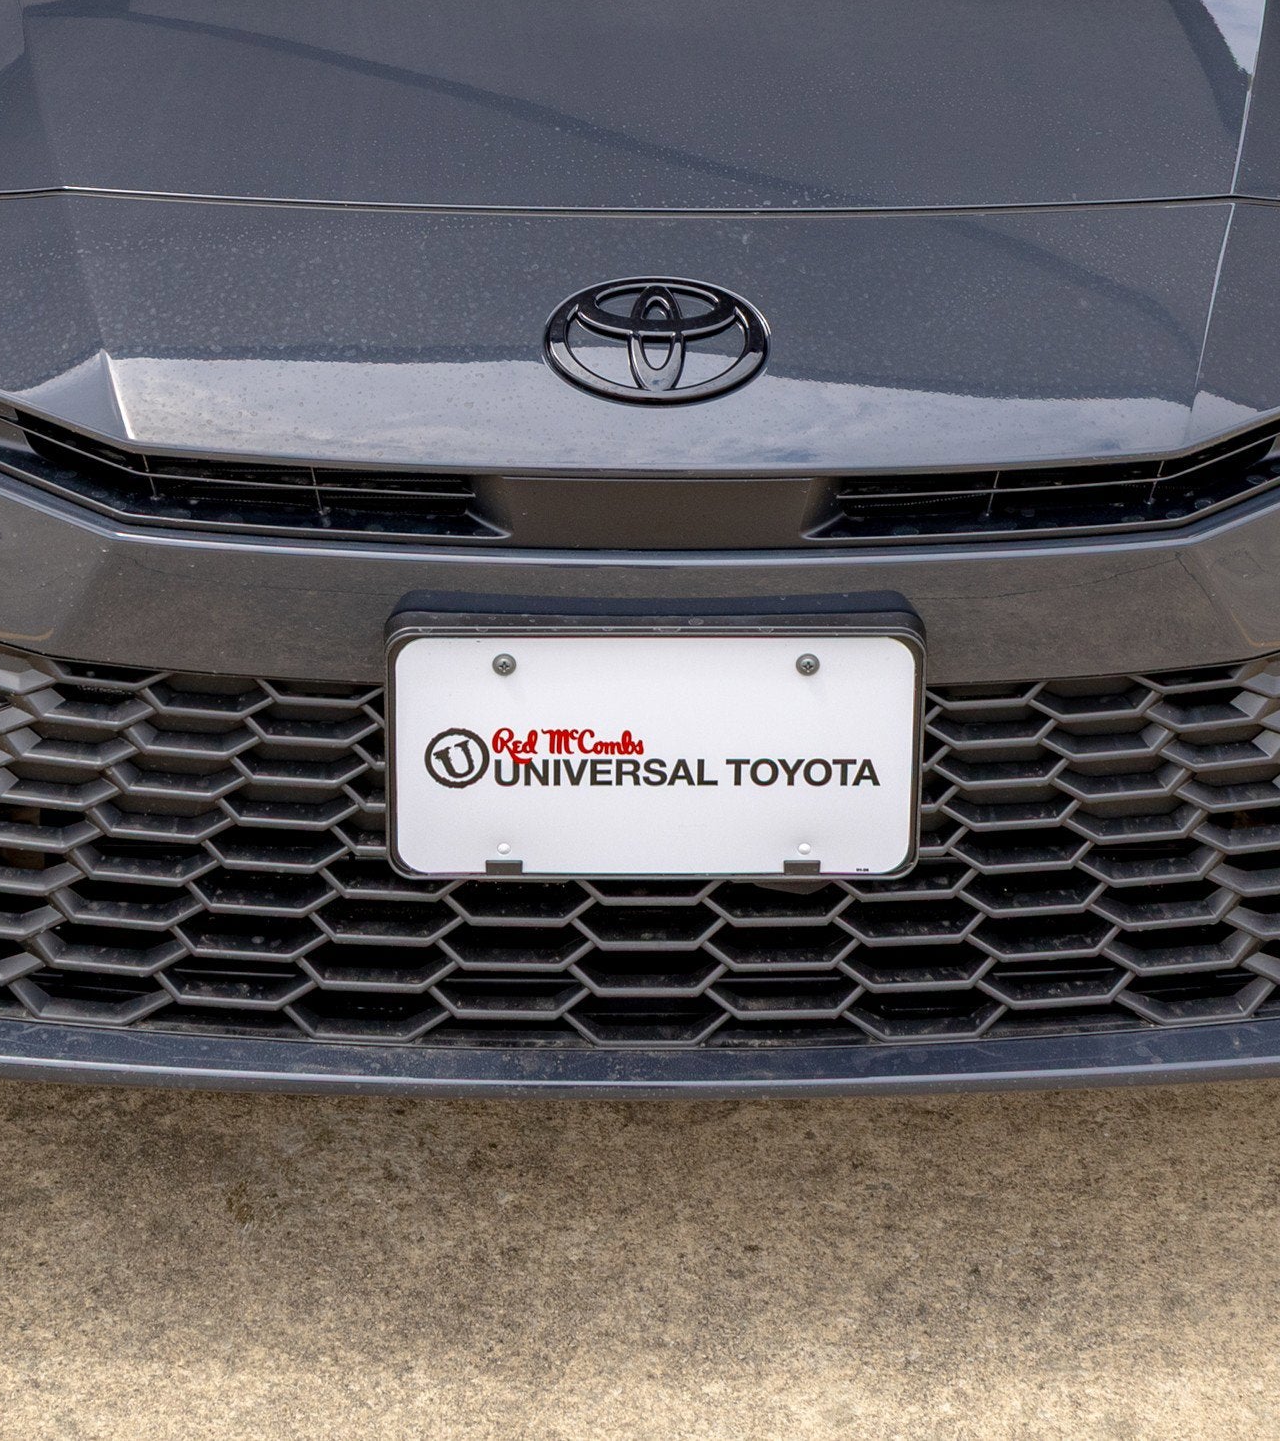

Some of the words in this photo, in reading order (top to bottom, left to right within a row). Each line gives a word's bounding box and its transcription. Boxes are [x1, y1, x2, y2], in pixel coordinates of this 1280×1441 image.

[492, 727, 538, 764] Red
[541, 728, 644, 755] McCombs
[494, 758, 718, 787] UNIVERSAL
[726, 758, 881, 787] TOYOTA
